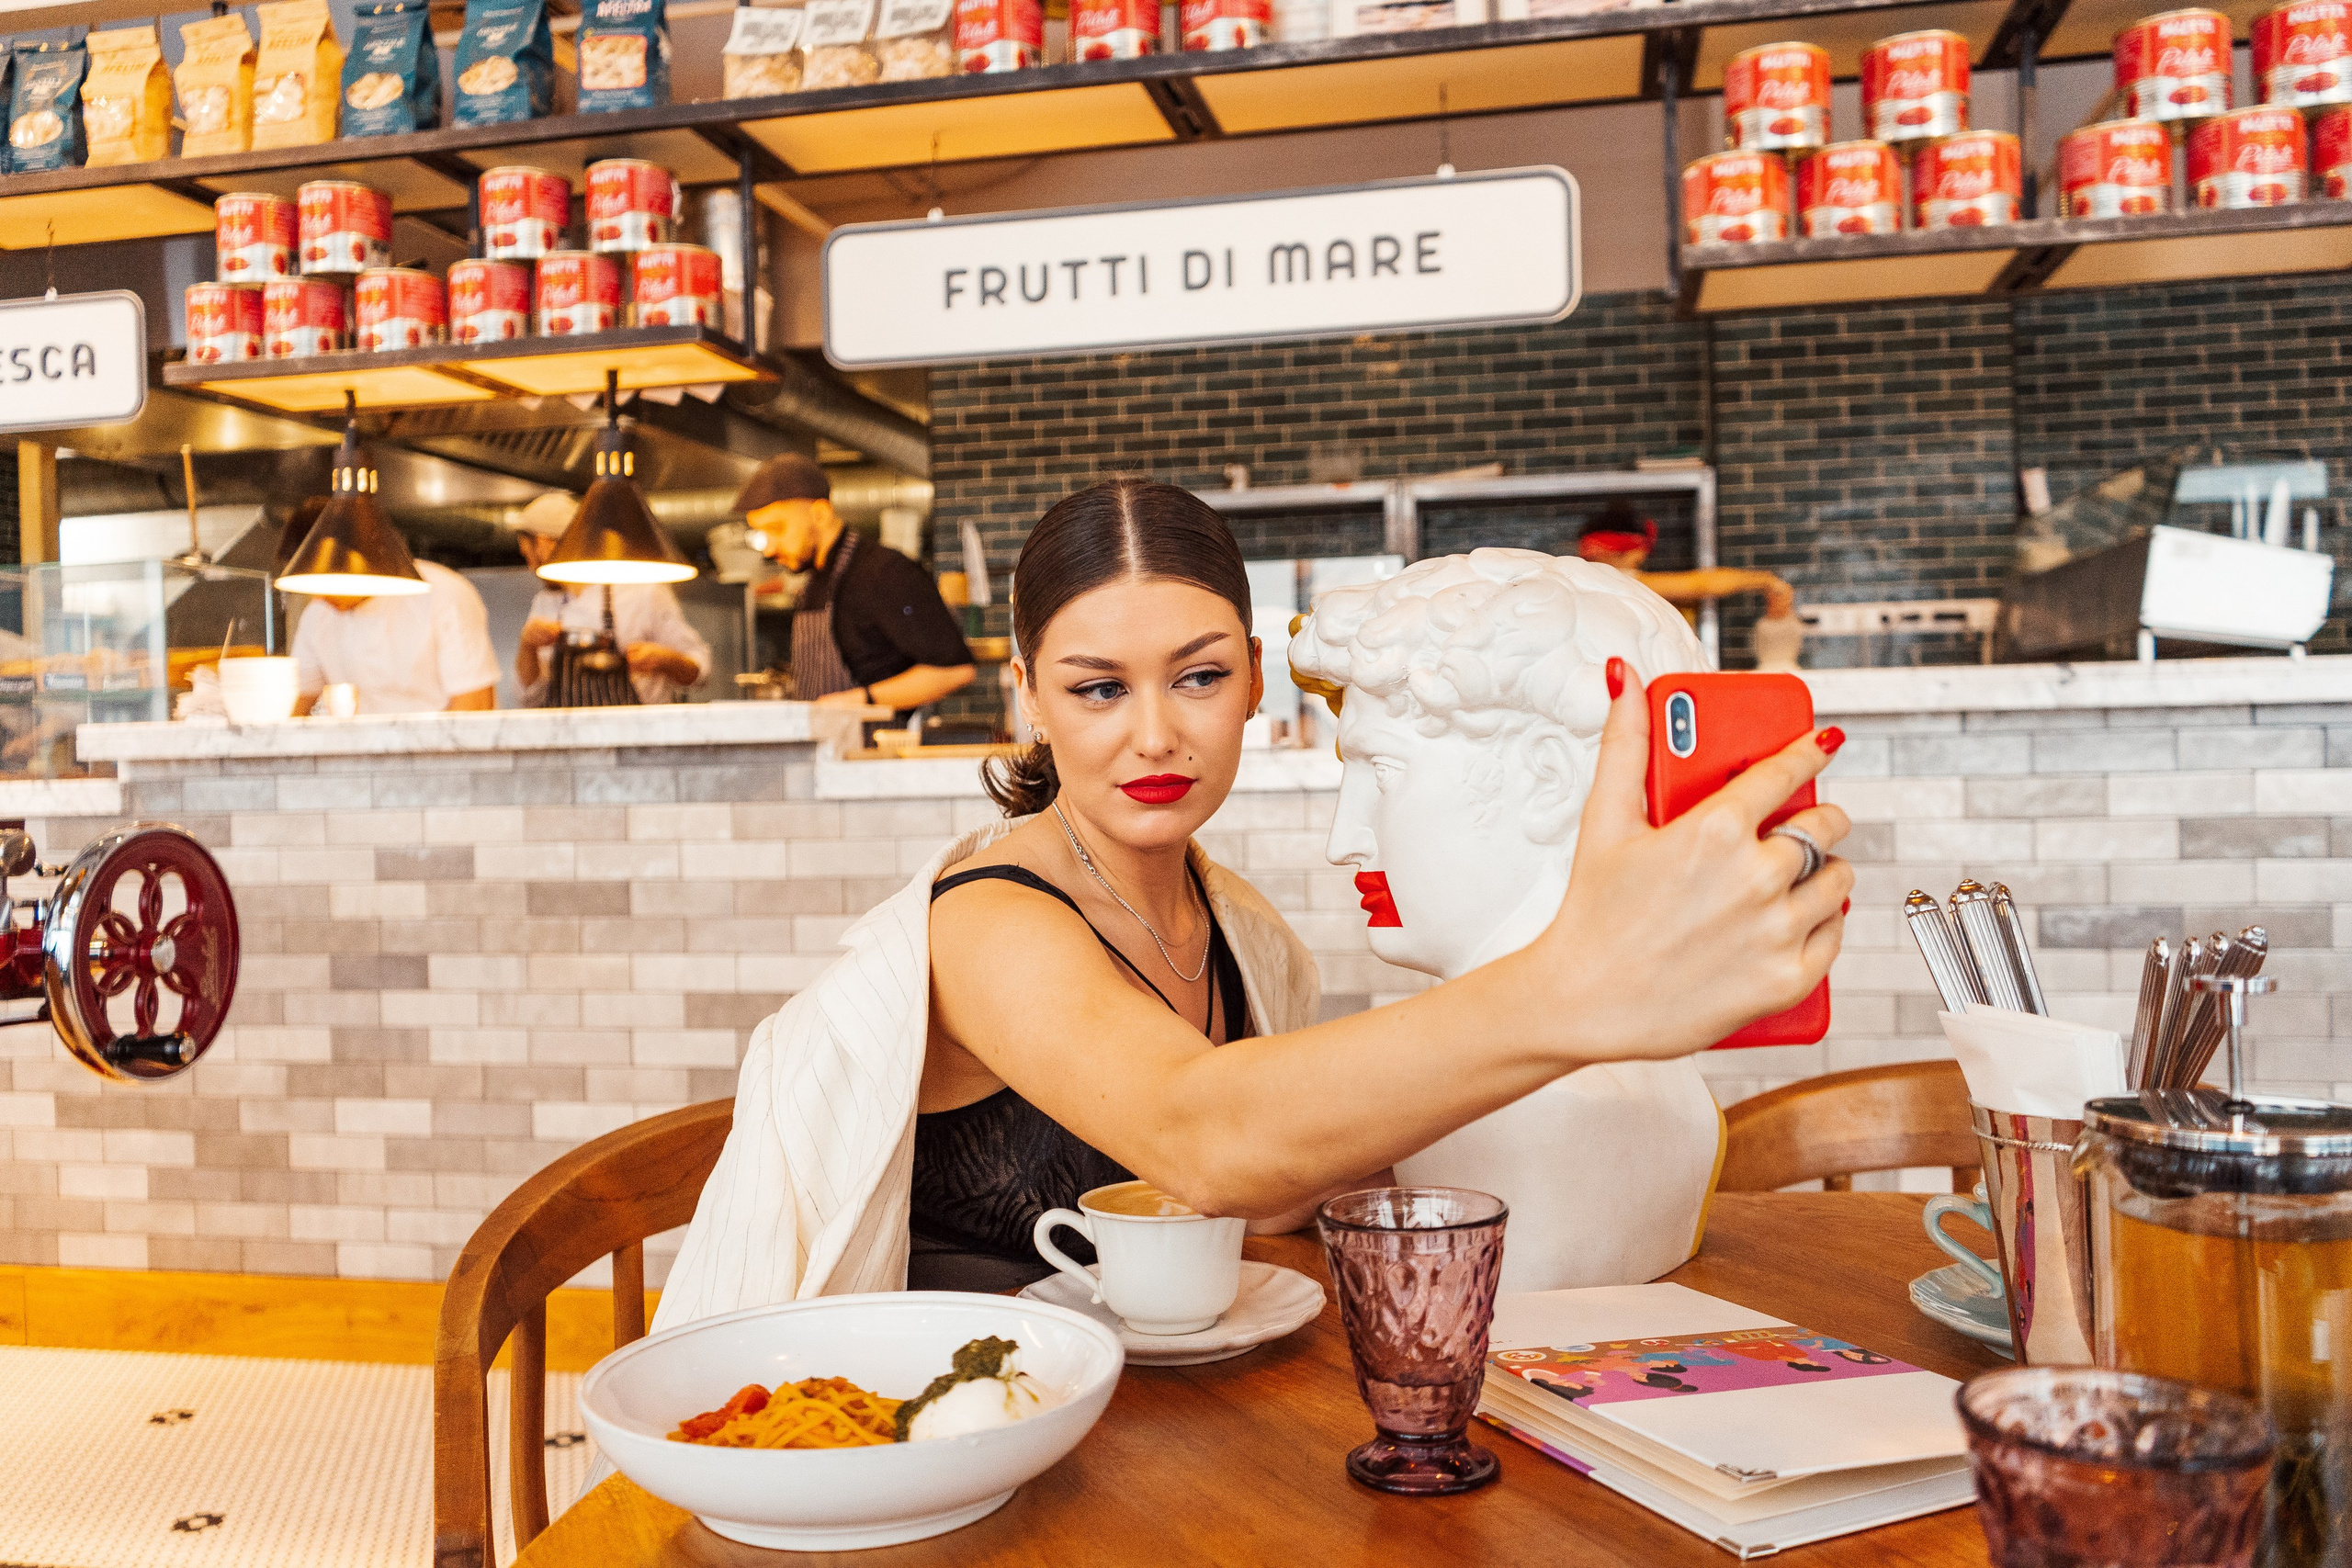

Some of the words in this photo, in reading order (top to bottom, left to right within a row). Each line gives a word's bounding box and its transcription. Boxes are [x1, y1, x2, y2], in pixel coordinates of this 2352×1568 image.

[944, 254, 1148, 309] FRUTTI
[1184, 246, 1232, 290] DI
[1269, 231, 1442, 283] MARE
[0, 343, 96, 383] SCA
